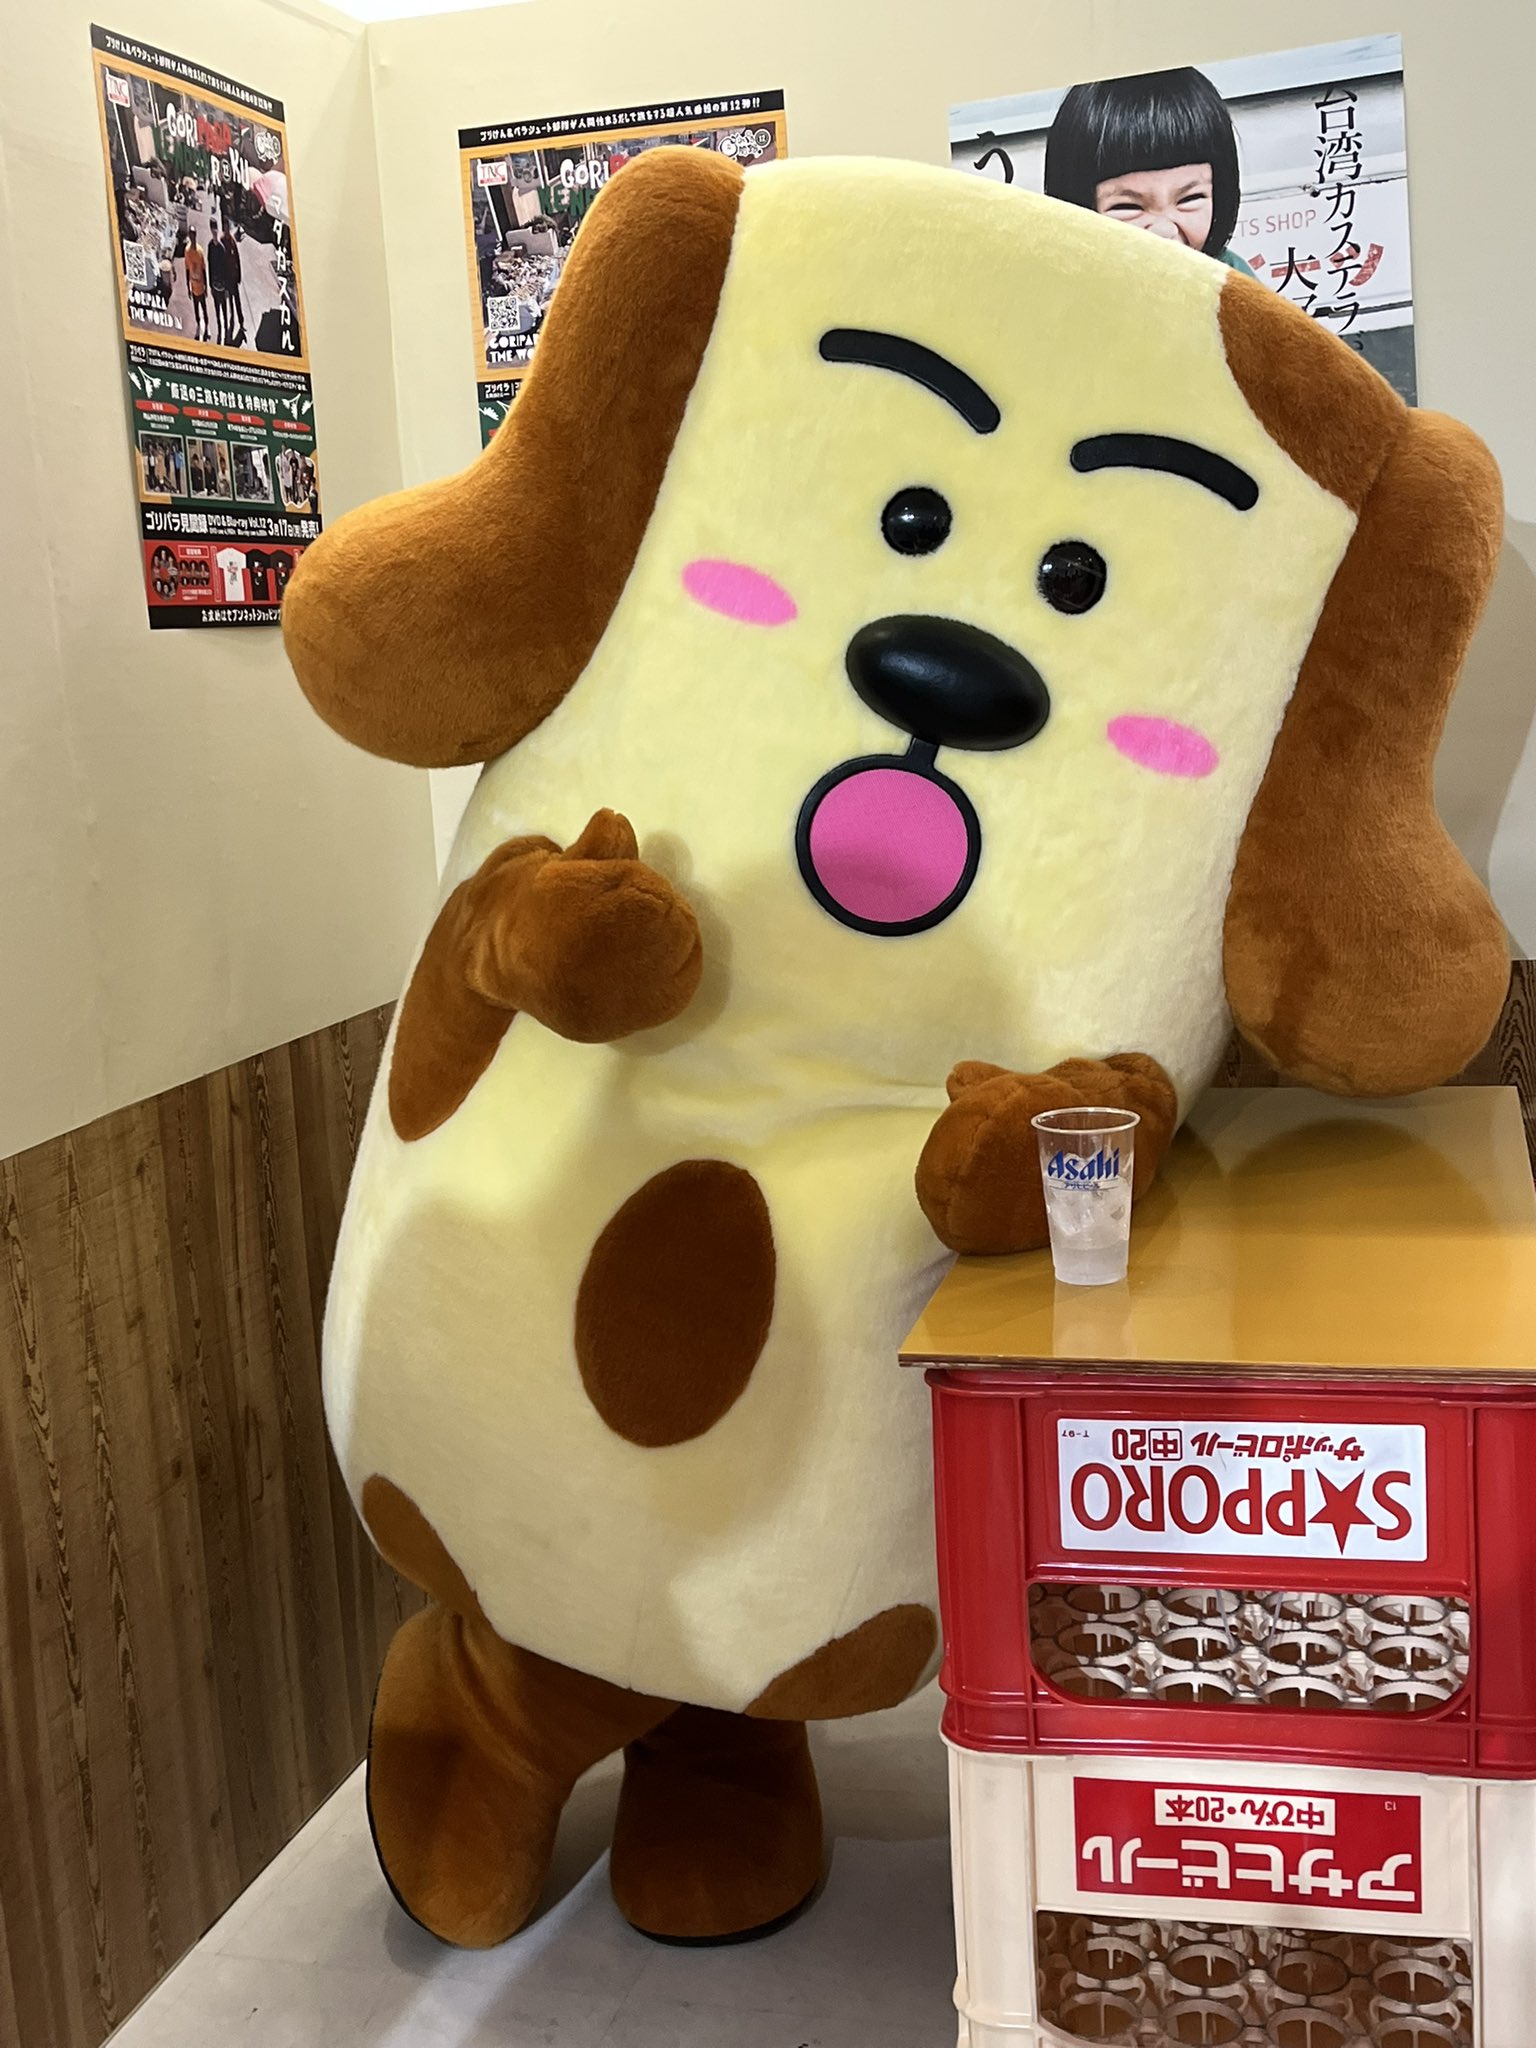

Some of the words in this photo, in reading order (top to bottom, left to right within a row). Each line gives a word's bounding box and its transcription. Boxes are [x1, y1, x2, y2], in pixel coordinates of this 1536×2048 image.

[1266, 210, 1317, 233] SHOP
[146, 310, 173, 328] WORLD
[1047, 1147, 1120, 1180] Asahi
[1190, 1431, 1365, 1463] サッポロビール
[1082, 1834, 1416, 1903] アサヒビール
